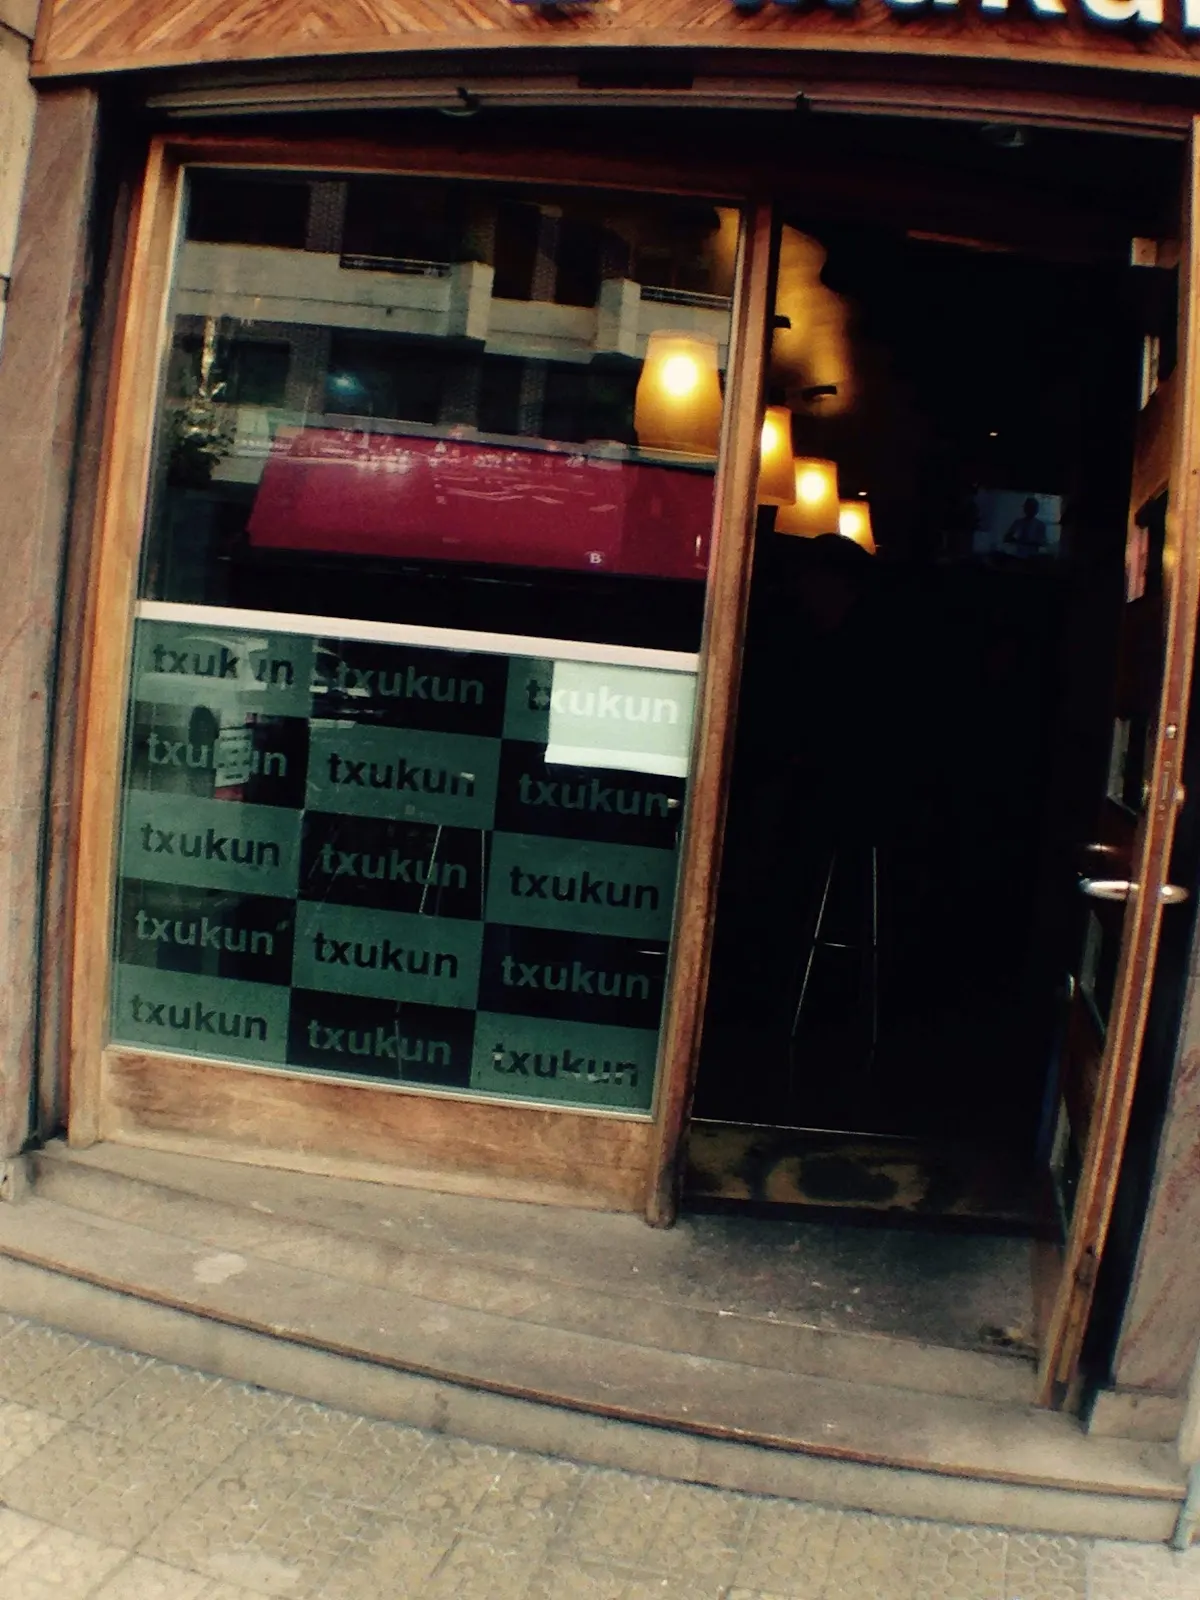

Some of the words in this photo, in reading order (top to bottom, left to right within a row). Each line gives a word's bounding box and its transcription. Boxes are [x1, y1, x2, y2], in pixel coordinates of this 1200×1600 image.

[336, 661, 484, 705] txukun
[527, 678, 679, 725] txukun
[147, 732, 287, 777] txun
[328, 752, 475, 798] txukun
[519, 772, 669, 818] txukun
[140, 822, 280, 868] txukun
[320, 843, 468, 890] txukun
[509, 865, 660, 911] txukun
[134, 909, 274, 956] txukun
[313, 931, 459, 979] txukun
[500, 955, 649, 1001] txukun
[131, 993, 268, 1042] txukun
[307, 1018, 452, 1066] txukun
[491, 1042, 639, 1088] txukun
